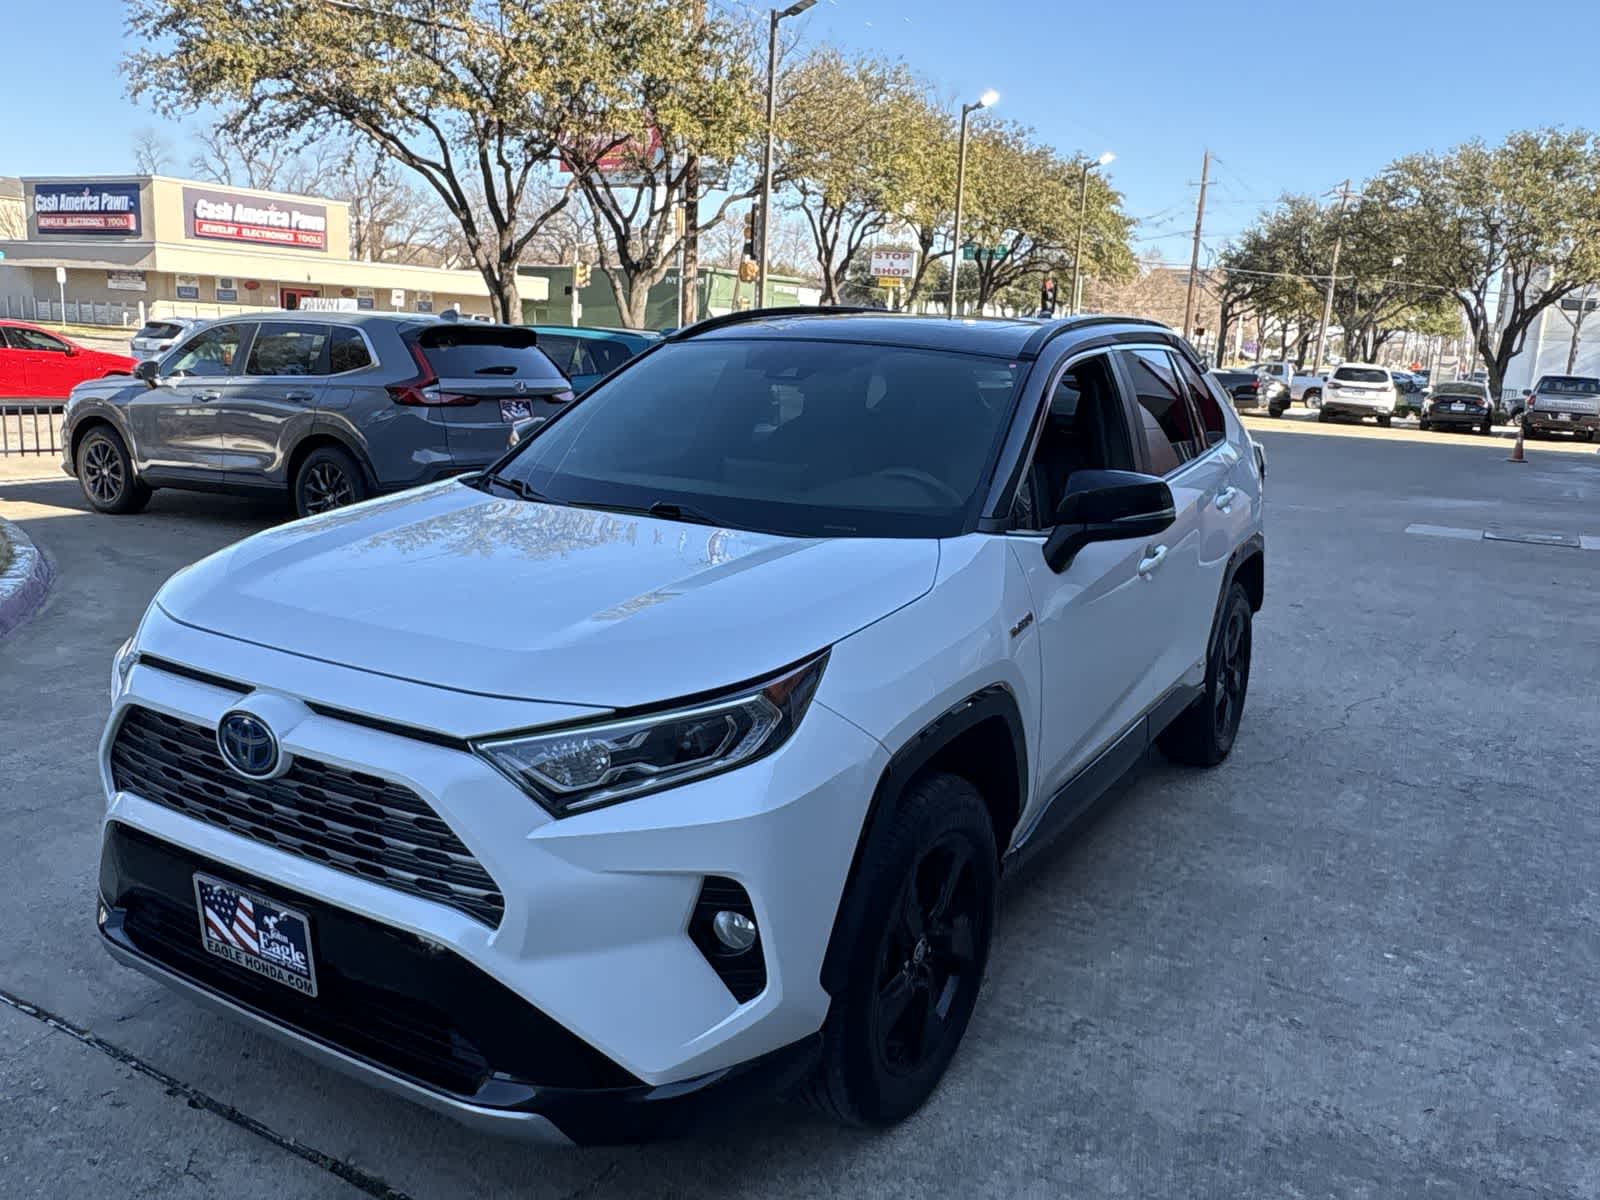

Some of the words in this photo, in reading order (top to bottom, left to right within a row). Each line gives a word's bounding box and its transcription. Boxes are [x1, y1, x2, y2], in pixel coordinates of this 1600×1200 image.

[35, 193, 58, 212] Cash
[60, 192, 100, 211] America
[101, 192, 130, 211] Pawn
[196, 198, 233, 220] Cash
[234, 203, 289, 228] America
[291, 210, 325, 232] Pawn
[201, 223, 239, 236] JEWELRY
[242, 227, 294, 241] ELECTRONICS
[297, 233, 322, 245] TOOLS
[874, 252, 911, 260] STOP
[874, 267, 910, 275] SHOP
[207, 940, 242, 962] EAGLE
[258, 930, 307, 965] Eagle
